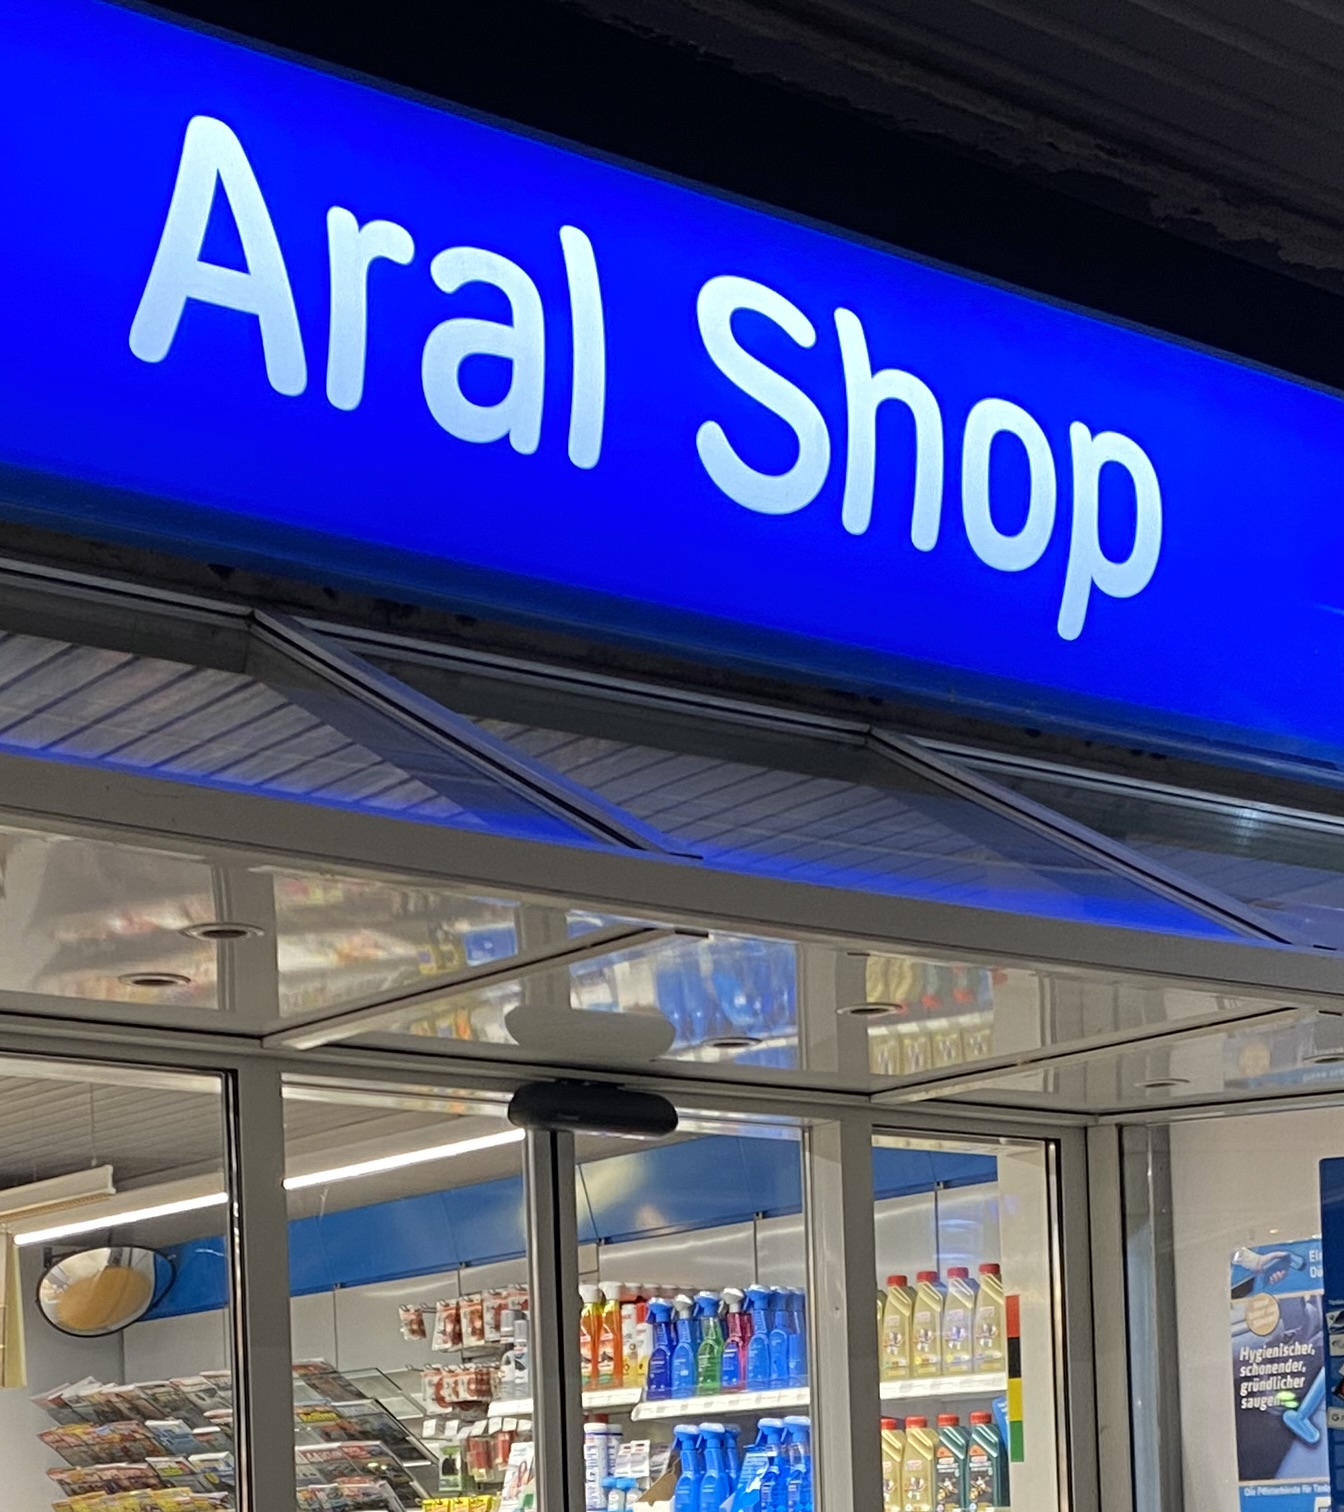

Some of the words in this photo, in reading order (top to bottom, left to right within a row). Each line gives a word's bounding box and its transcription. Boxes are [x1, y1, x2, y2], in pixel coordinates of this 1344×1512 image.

[129, 115, 606, 468] Aral
[696, 275, 1163, 641] Shop
[1239, 1342, 1315, 1363] Hygienischer,
[1240, 1359, 1306, 1377] schonender,
[1240, 1376, 1305, 1397] gründlicher
